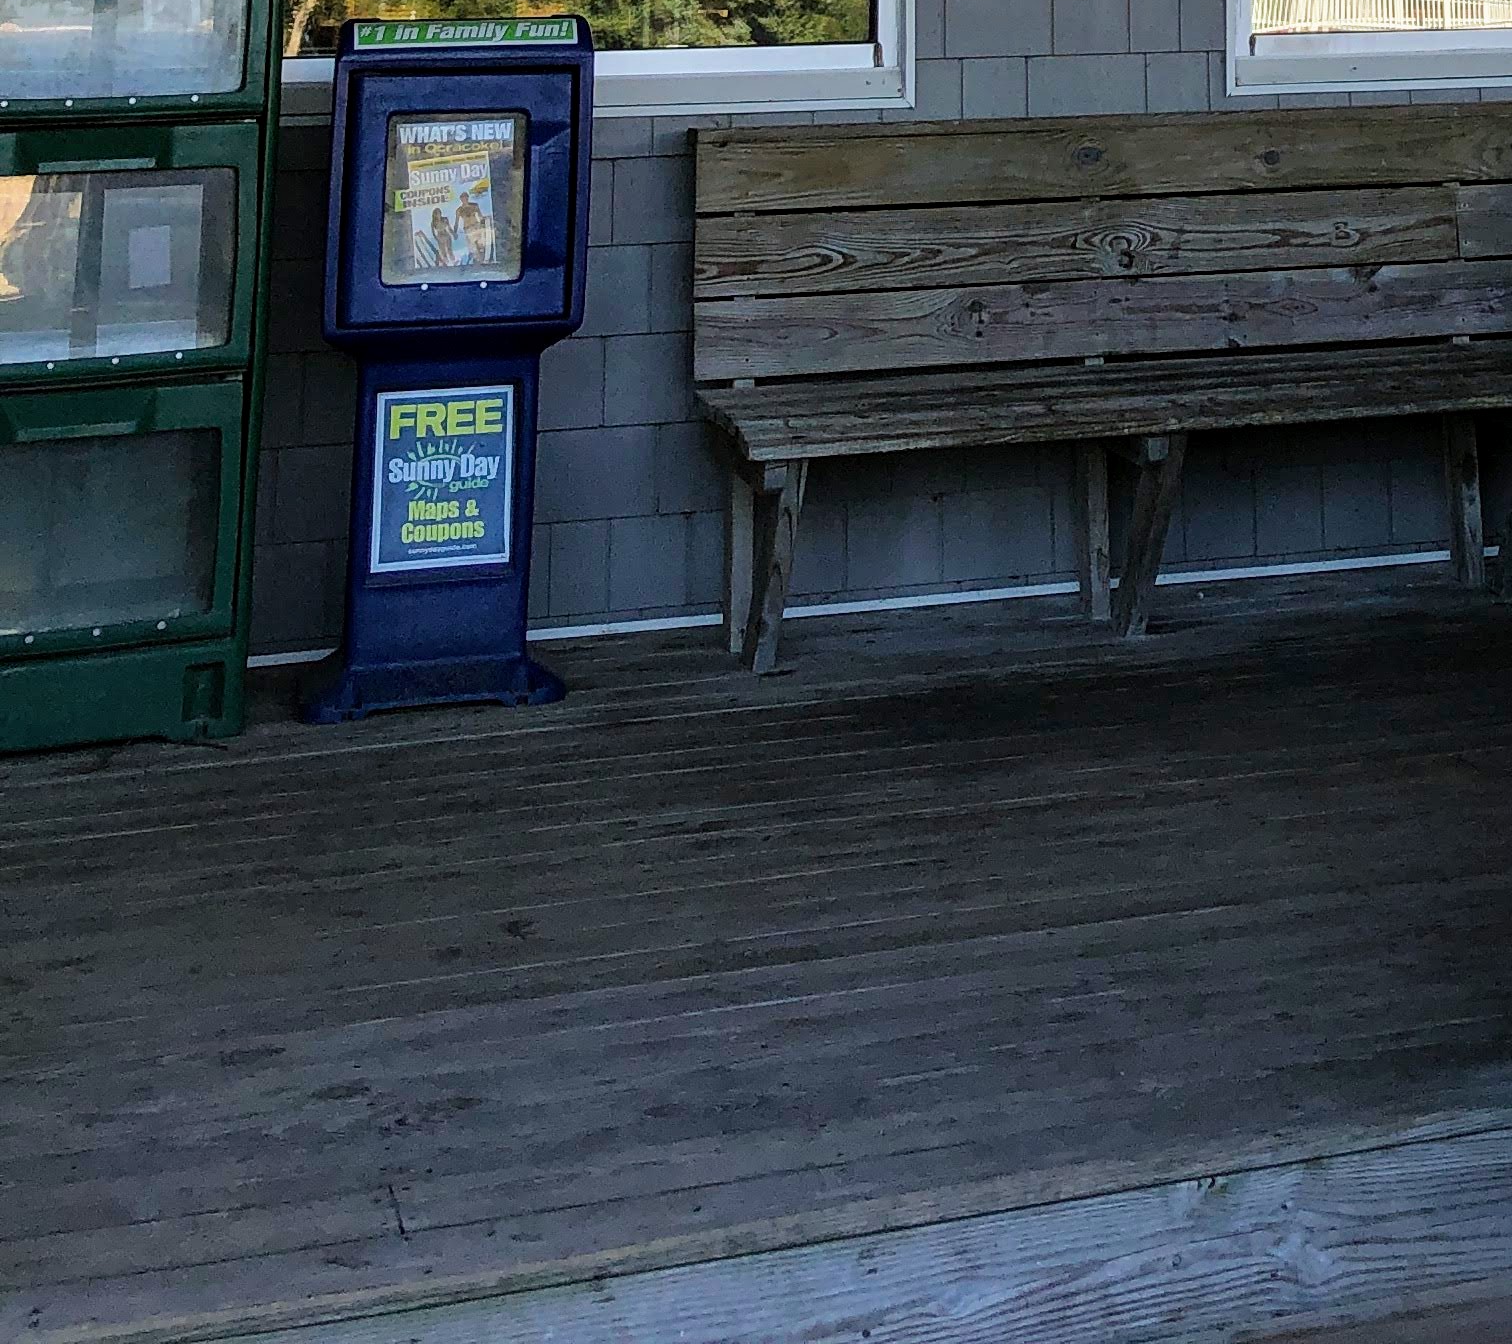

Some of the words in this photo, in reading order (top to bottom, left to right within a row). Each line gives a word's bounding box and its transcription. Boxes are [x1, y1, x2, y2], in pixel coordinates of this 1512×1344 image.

[360, 25, 386, 41] #1
[425, 22, 509, 43] Family
[515, 21, 569, 37] Fun!
[400, 124, 467, 144] WHAT'S
[471, 122, 512, 141] NEW
[411, 167, 457, 186] Sunny
[460, 163, 488, 181] Day
[401, 185, 451, 201] COUPONS
[389, 398, 503, 440] FREE
[388, 457, 456, 483] Sunny
[460, 453, 500, 480] Day
[449, 477, 489, 492] guide
[408, 500, 460, 521] Maps
[464, 499, 479, 517] &
[401, 520, 485, 544] Coupons
